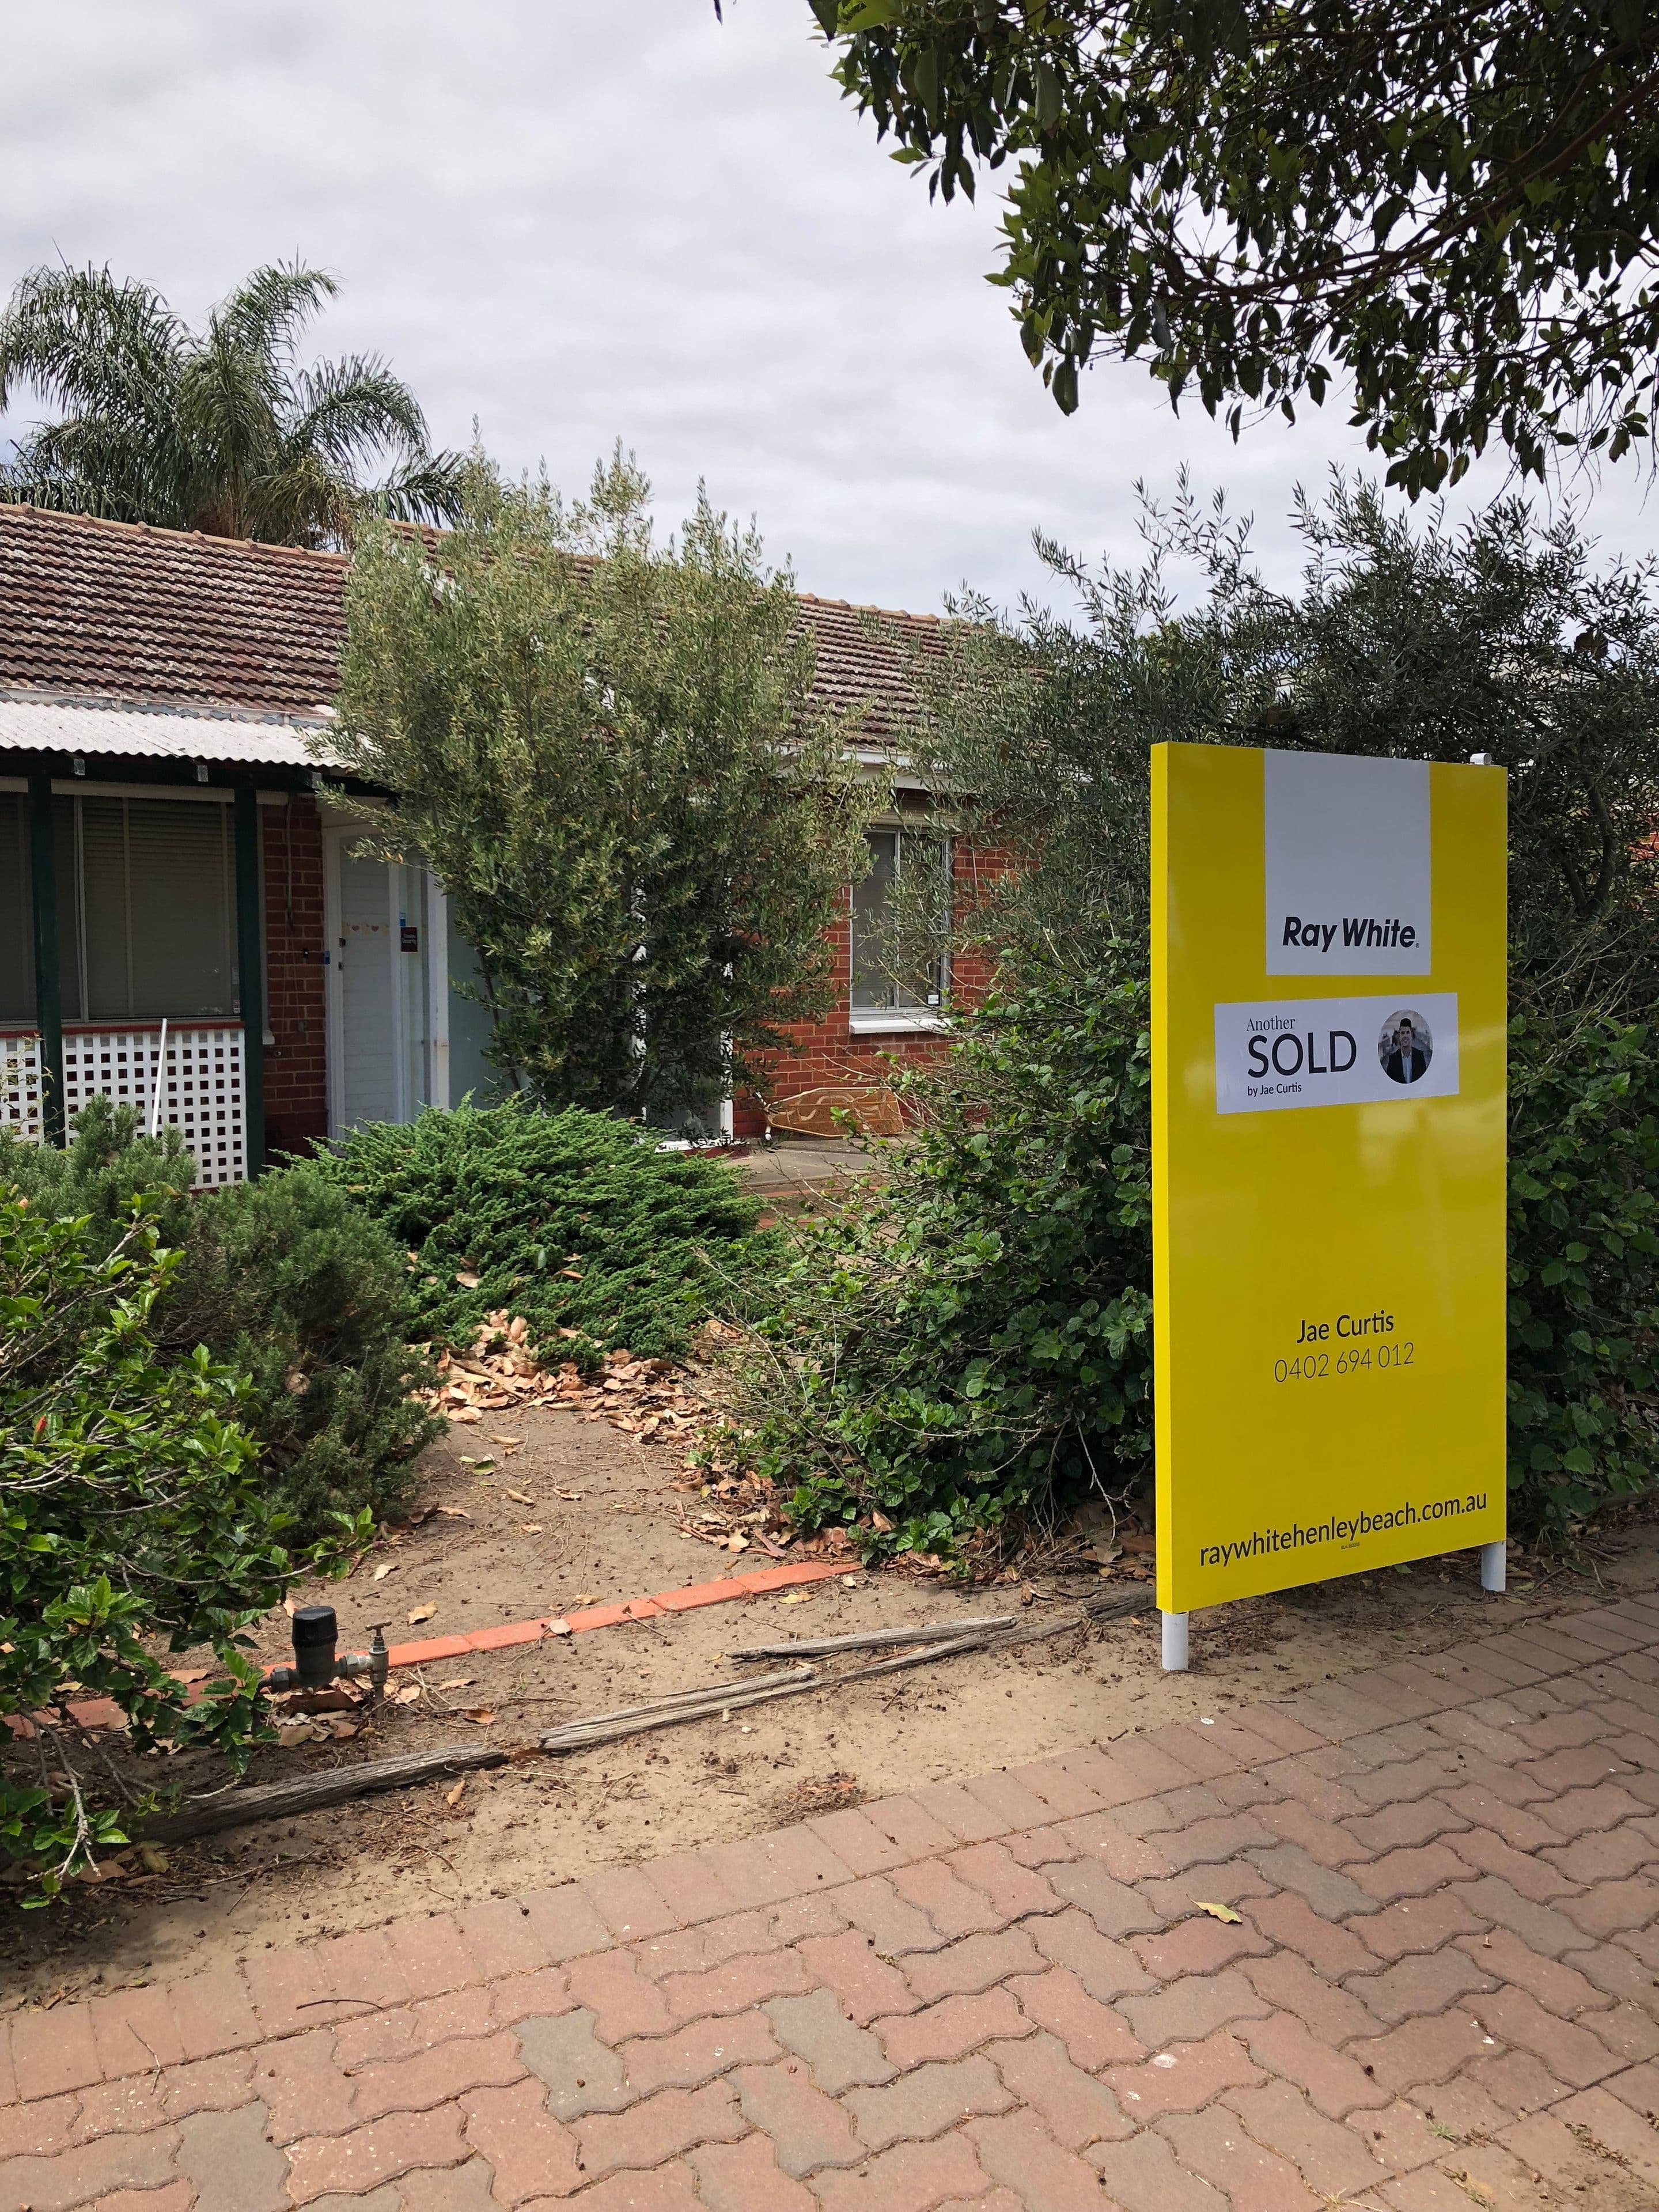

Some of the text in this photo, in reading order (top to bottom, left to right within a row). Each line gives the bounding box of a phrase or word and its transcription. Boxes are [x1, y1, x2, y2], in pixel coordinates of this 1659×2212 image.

[1282, 916, 1416, 953] Ray White
[1246, 1015, 1296, 1032] Another
[1247, 1030, 1357, 1078] SOLD
[1247, 1082, 1302, 1098] by Jae Curtis
[1297, 1309, 1394, 1343] Jae Curtis
[1274, 1342, 1414, 1382] 0402 694 012
[1200, 1493, 1487, 1567] raywhitehenleybeach.com.au
